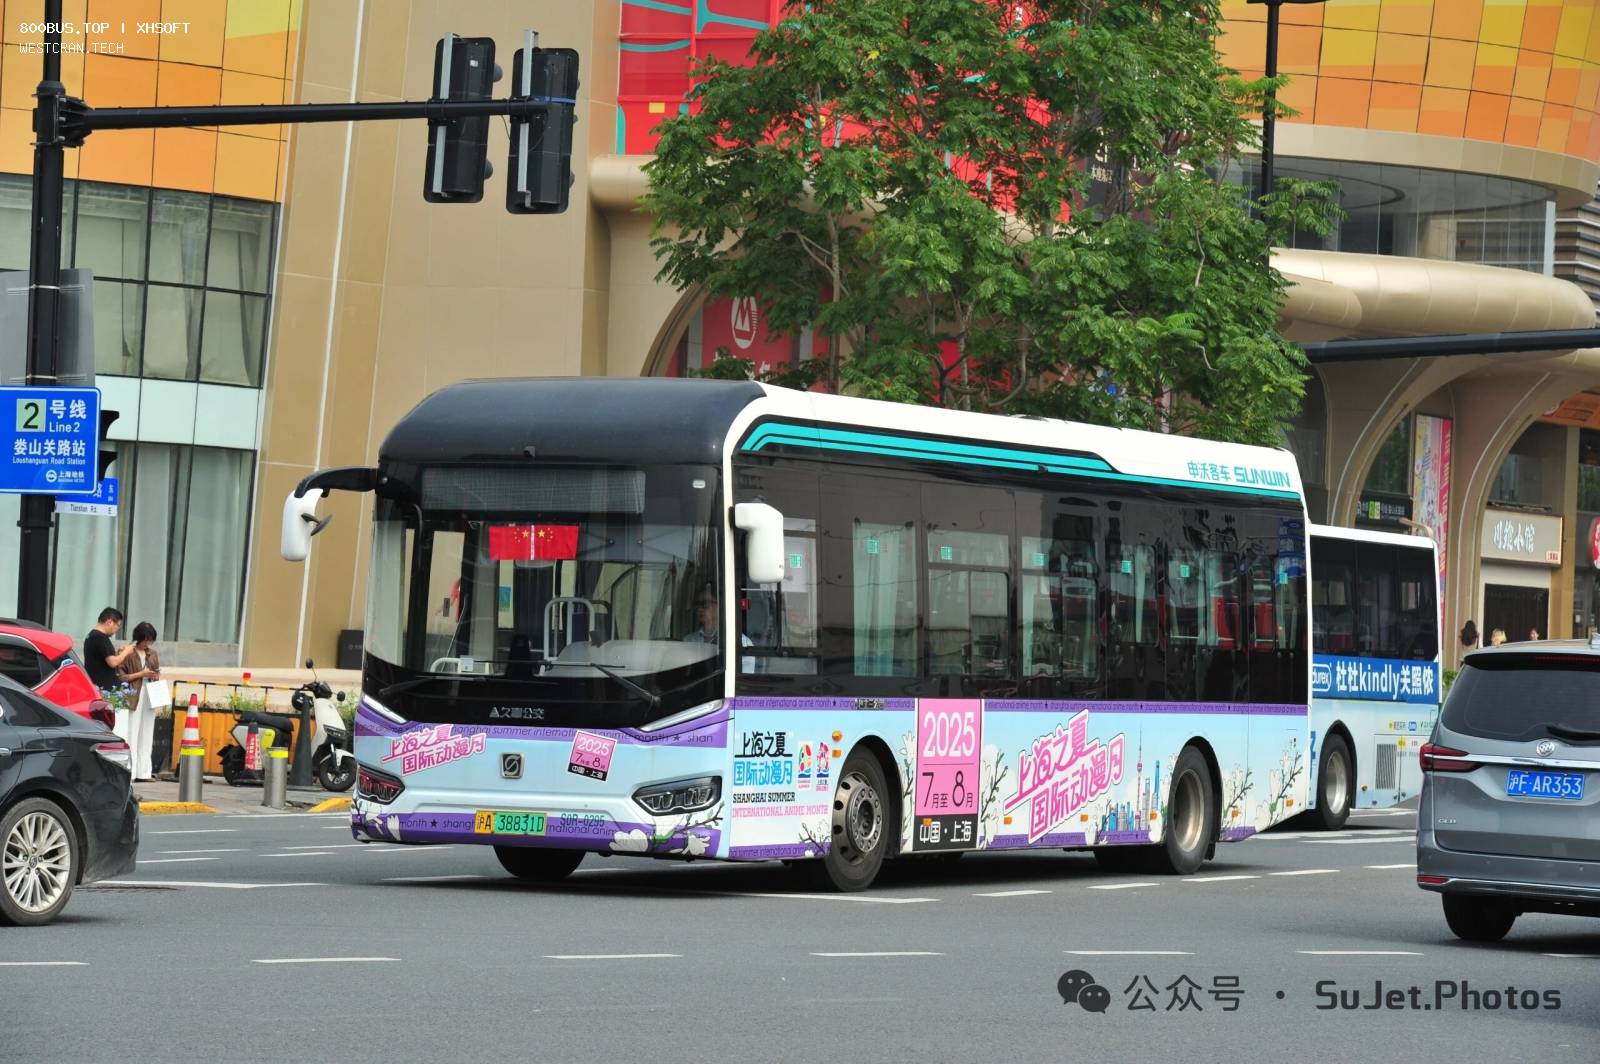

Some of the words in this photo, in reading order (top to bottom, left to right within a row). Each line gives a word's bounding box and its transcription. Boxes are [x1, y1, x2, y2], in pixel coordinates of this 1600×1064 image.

[23, 402, 39, 429] 2
[49, 399, 87, 419] 号线
[49, 421, 72, 433] Line
[73, 422, 80, 432] 2
[13, 438, 86, 457] 娄山关路站
[50, 456, 65, 465] Road
[66, 457, 86, 466] Station
[1187, 461, 1231, 481] 申沃客车
[1234, 466, 1291, 488] SUNWIN
[451, 720, 491, 737] hanghai
[923, 711, 976, 758] 2025
[577, 737, 610, 756] 2025
[734, 731, 793, 759] 上海之夏
[1004, 713, 1099, 811] 上海之夏
[733, 760, 793, 787] 国际动漫月
[733, 792, 767, 804] SHANGHAI
[768, 792, 796, 803] SUMMER
[1029, 737, 1124, 840] 国际动漫月
[732, 806, 783, 818] INTERNATIONAL
[784, 805, 804, 817] ANIME
[497, 814, 544, 833] 38831D
[919, 820, 941, 844] 中国
[950, 820, 972, 842] 上海
